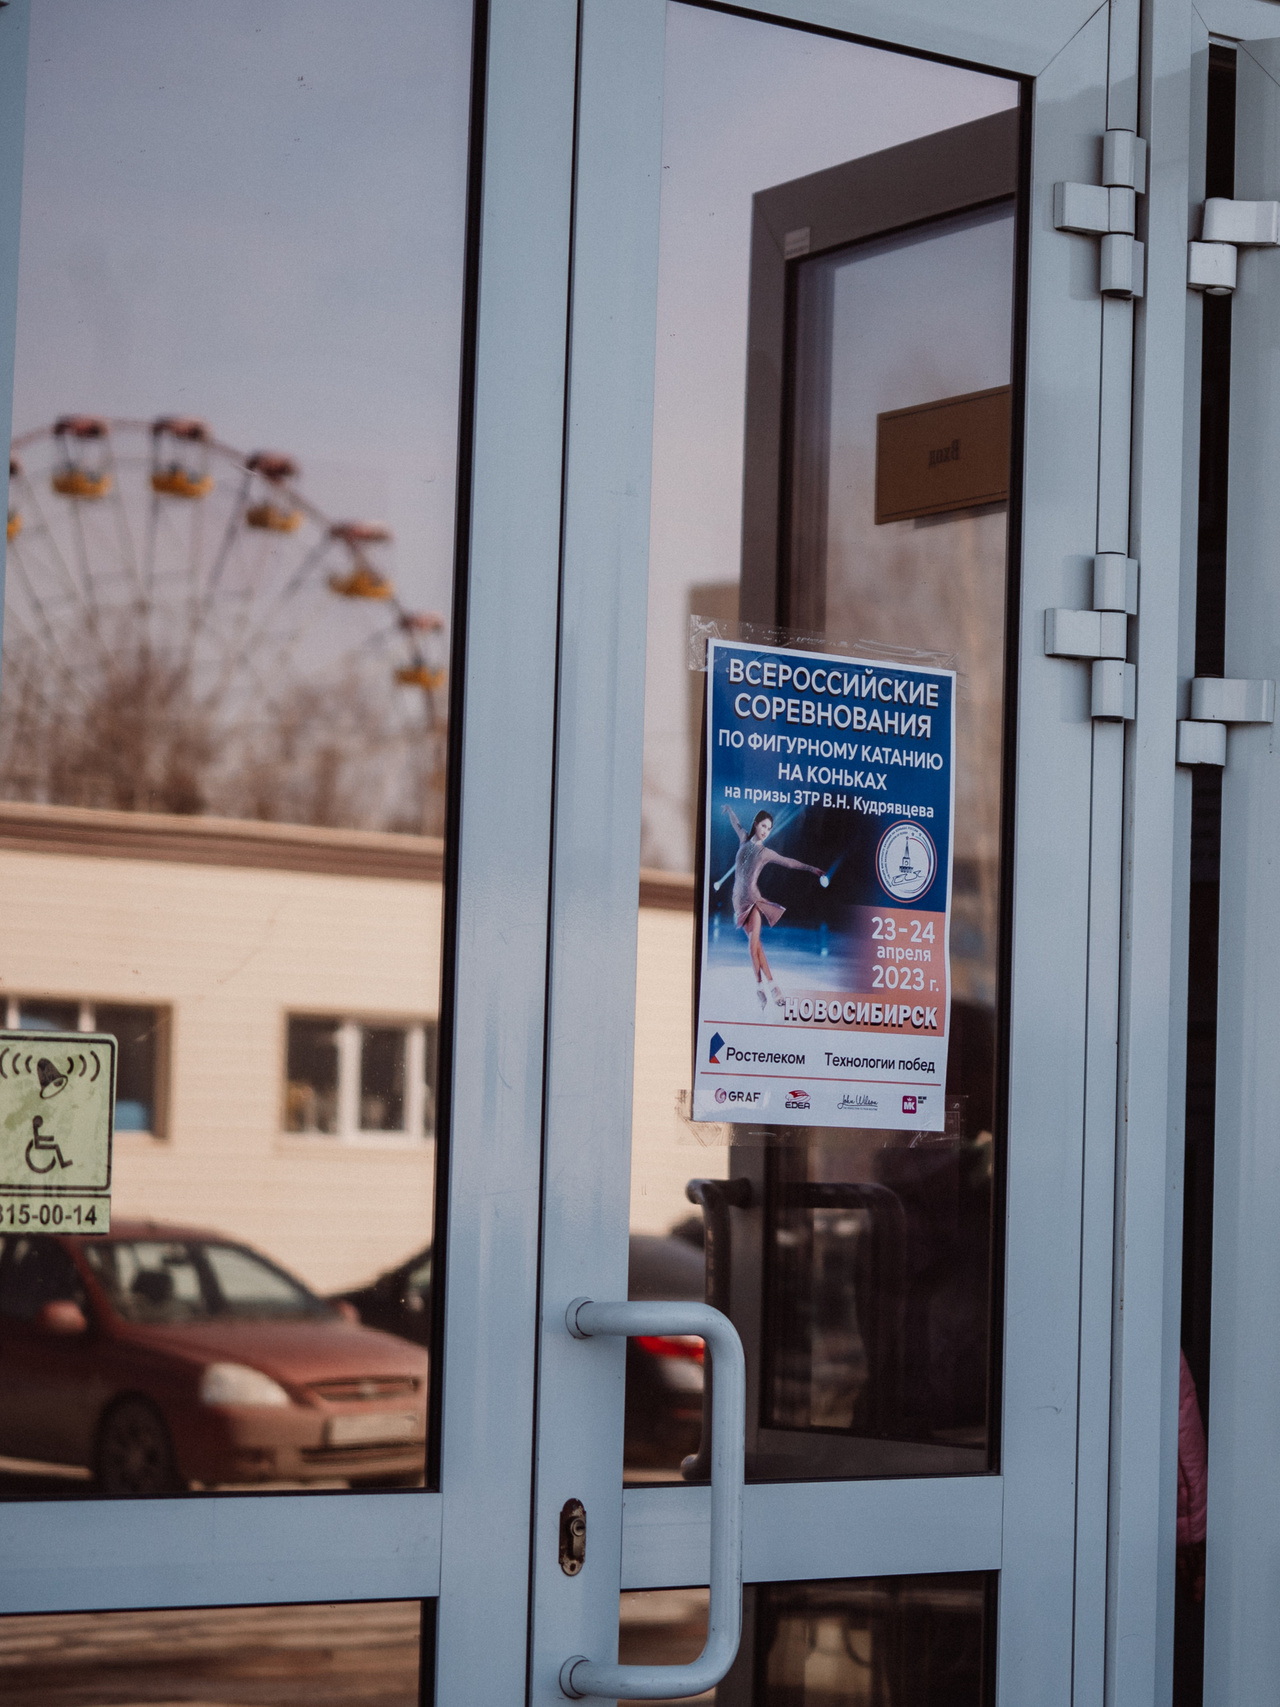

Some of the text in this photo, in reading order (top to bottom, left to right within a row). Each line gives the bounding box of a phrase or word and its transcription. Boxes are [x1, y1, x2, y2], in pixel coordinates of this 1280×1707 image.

[728, 658, 940, 707] ВСЕРОССИЙСКИЕ
[734, 692, 932, 739] СОРЕВНОВАНИЯ
[718, 728, 943, 771] ПО ФИГУРНОМУ КАТАНИЮ
[778, 762, 888, 791] НА КОНЬКАХ
[724, 786, 934, 819] на призы ЗТР В.Н. Кудрявцева
[871, 916, 936, 944] 23-24
[876, 946, 931, 963] апреля
[871, 964, 940, 993] 2023 г.
[784, 997, 938, 1029] НОВОСИБИРСК
[726, 1047, 806, 1065] Ростелеком
[825, 1052, 936, 1074] Технологии побед
[728, 1090, 761, 1103] GRAF
